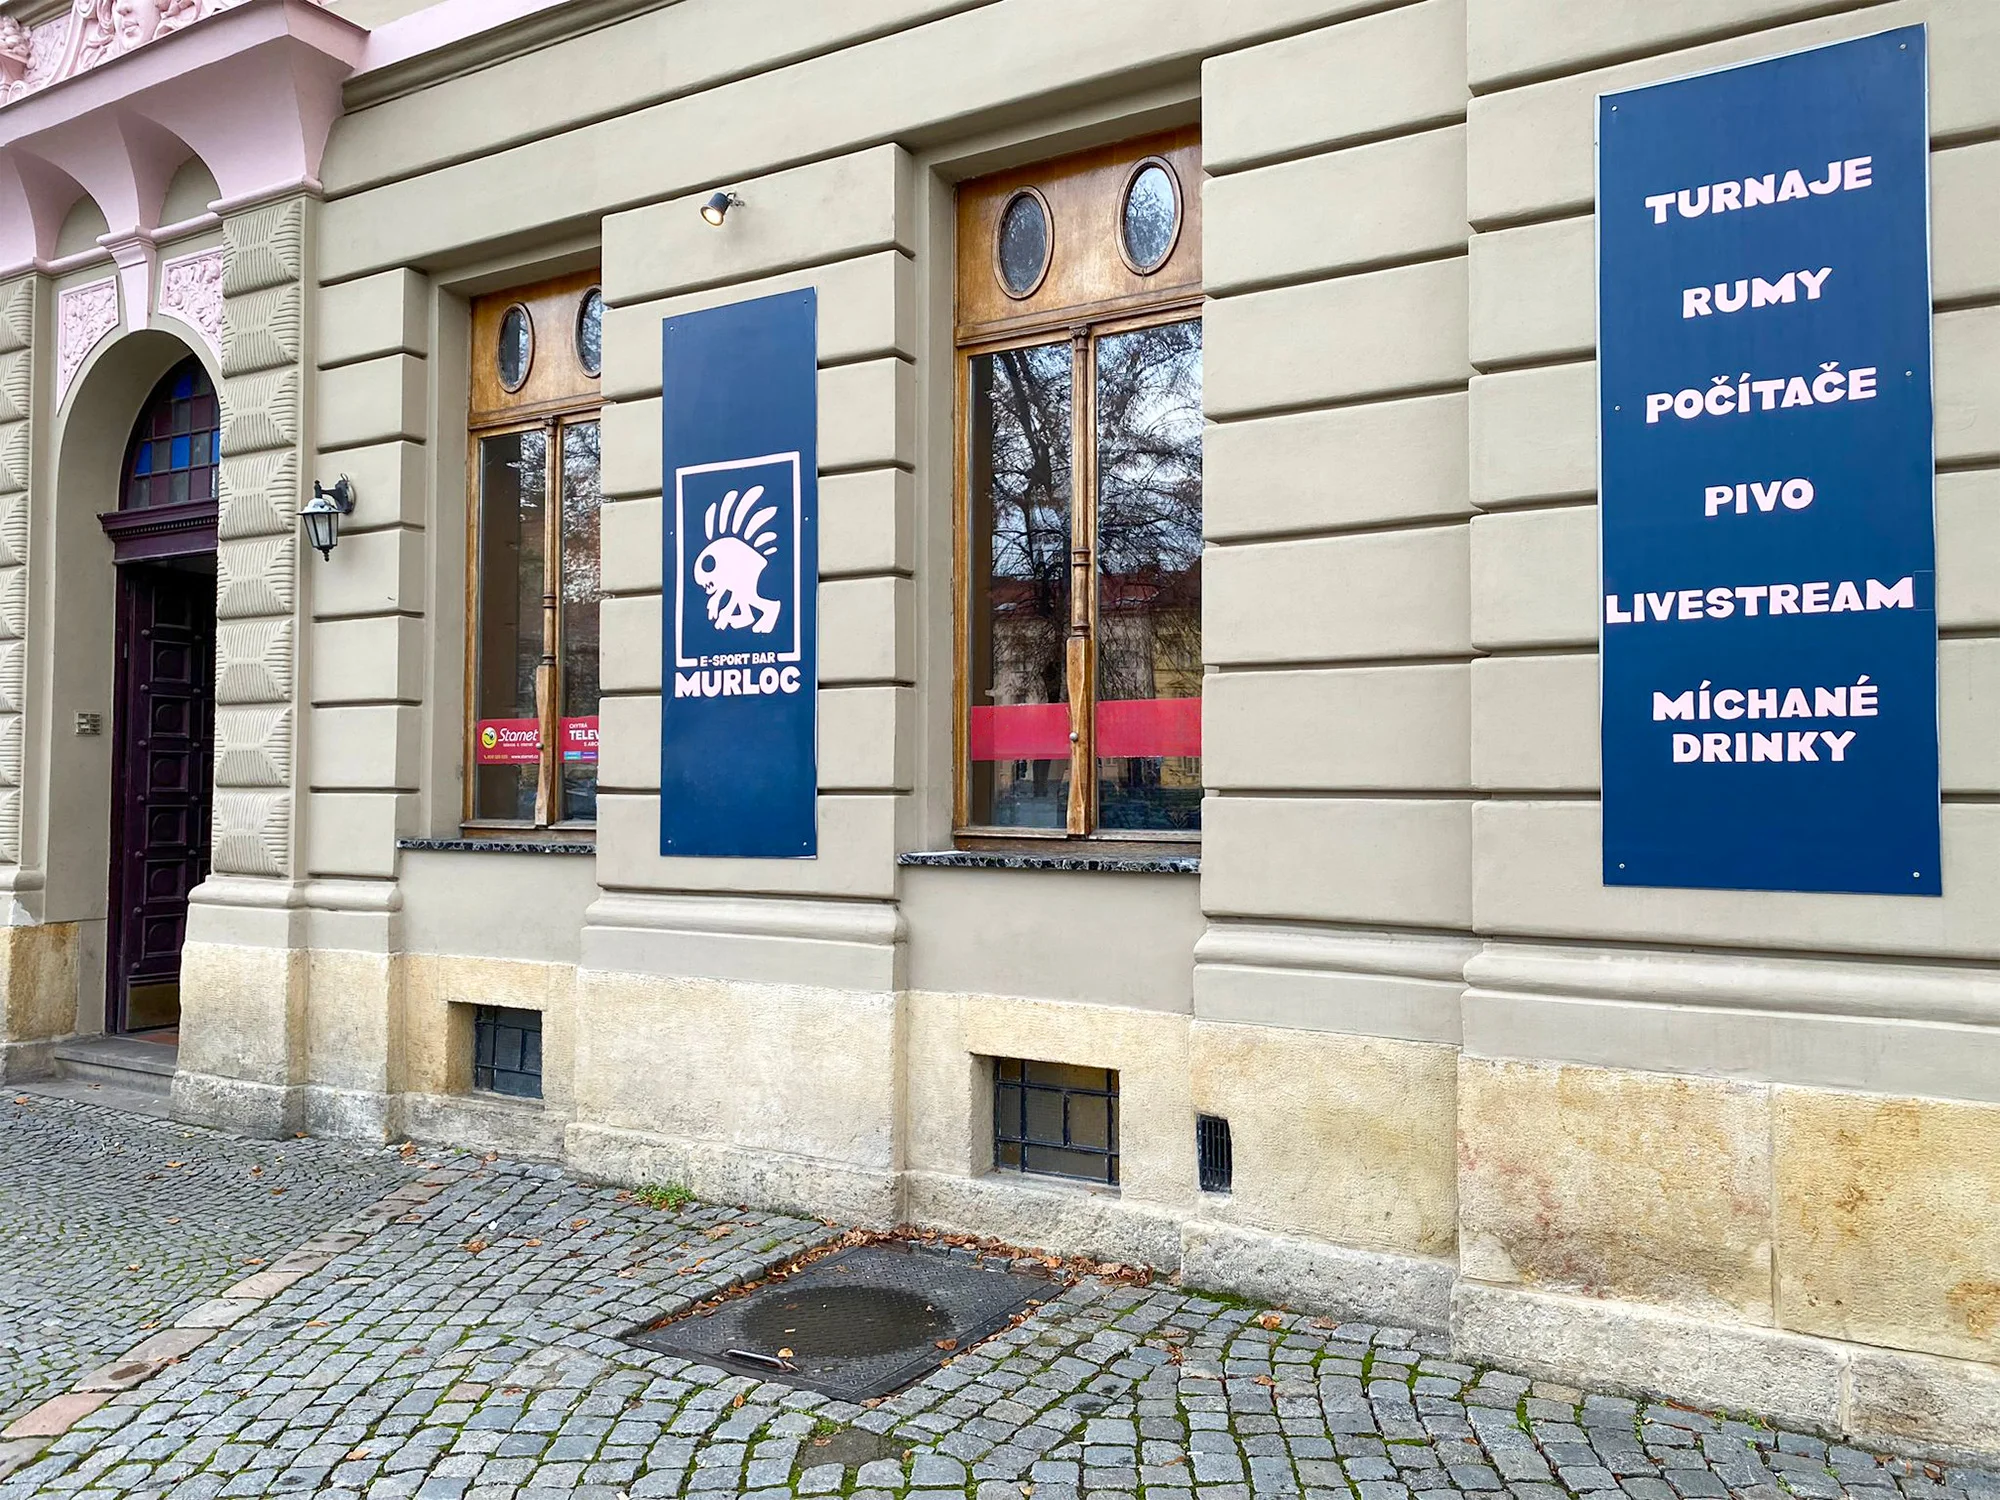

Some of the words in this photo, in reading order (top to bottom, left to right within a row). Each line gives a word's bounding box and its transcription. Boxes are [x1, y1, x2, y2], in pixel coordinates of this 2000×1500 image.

[1645, 156, 1872, 224] TURNAJE
[1683, 268, 1832, 318] RUMY
[1647, 362, 1876, 423] POČÍTAČE
[1705, 479, 1813, 516] PIVO
[1606, 577, 1913, 623] LIVESTREAM
[675, 666, 800, 697] MURLOC
[700, 654, 750, 666] E-SPORT
[752, 652, 775, 664] BAR
[1653, 675, 1877, 720] MÍCHANÉ
[1673, 731, 1855, 762] DRINKY
